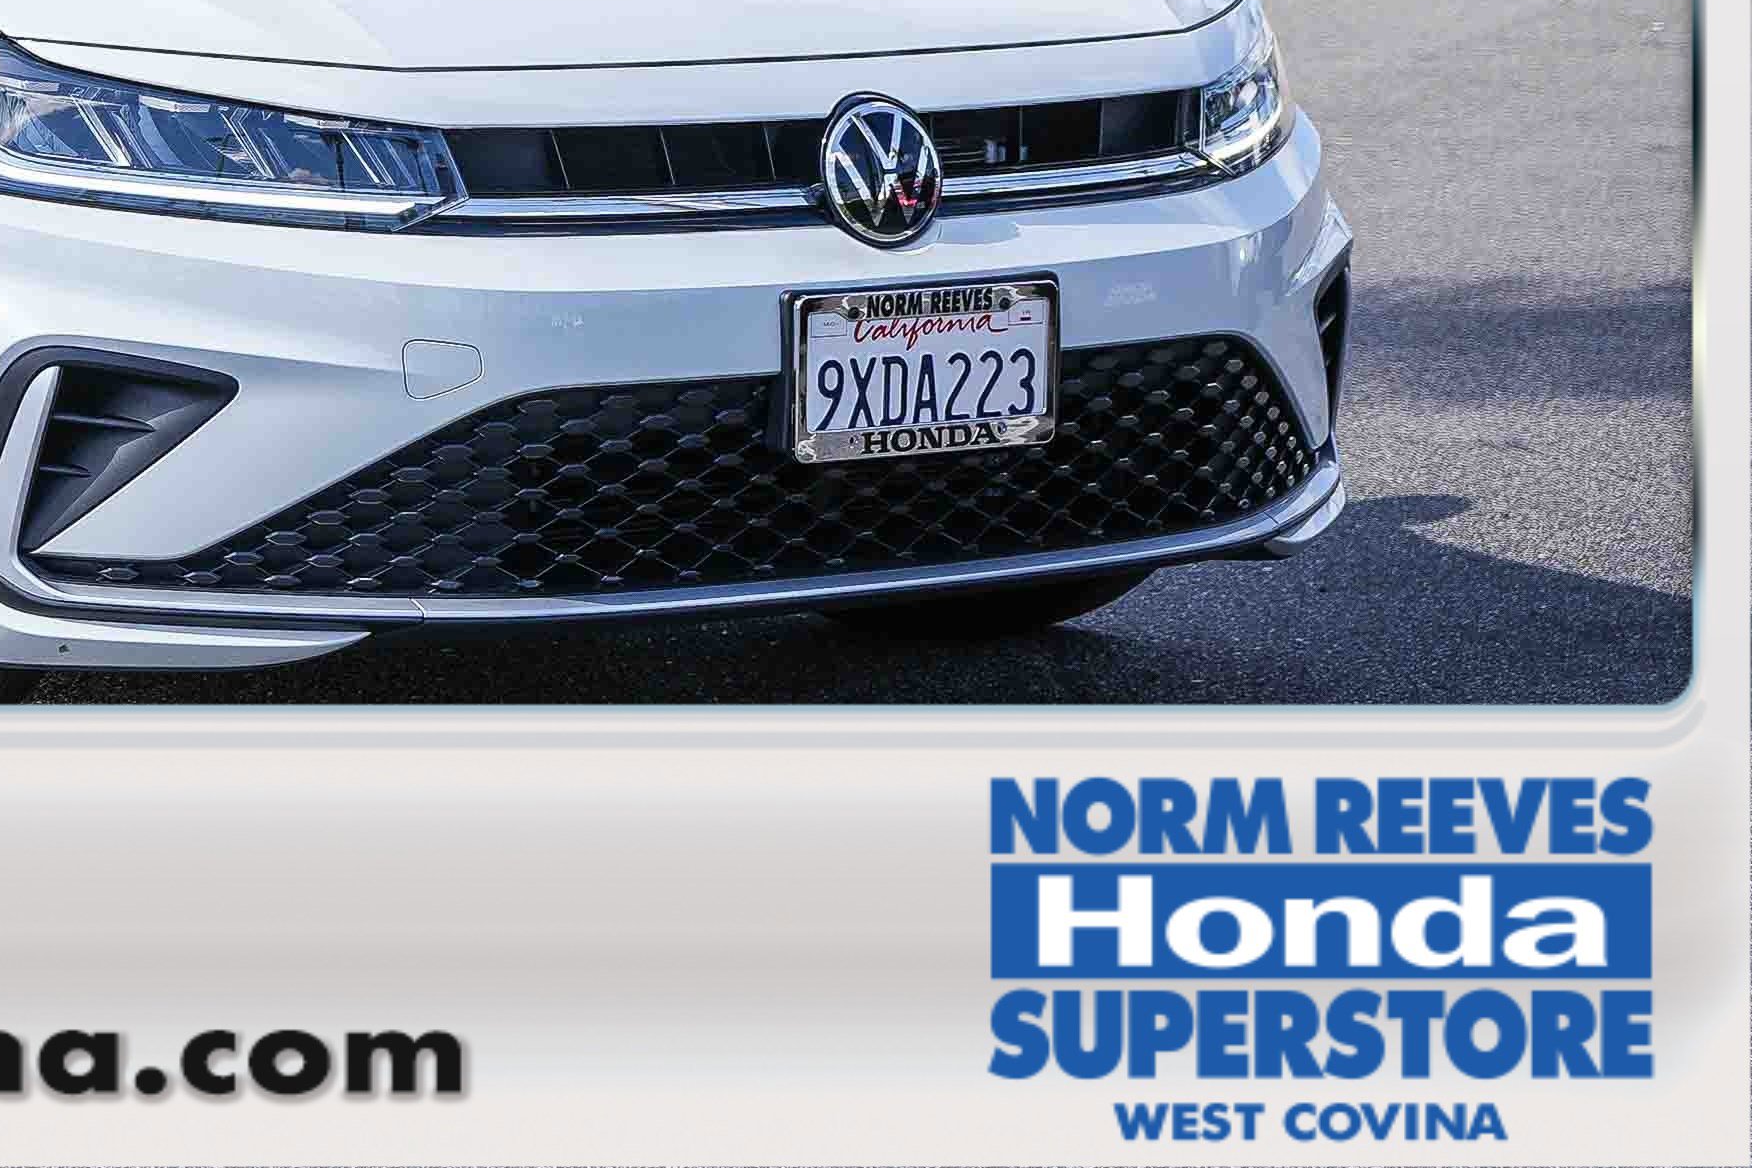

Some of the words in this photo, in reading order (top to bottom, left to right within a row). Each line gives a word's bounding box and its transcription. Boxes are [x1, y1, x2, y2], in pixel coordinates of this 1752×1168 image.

[866, 292, 923, 319] NORM
[931, 288, 993, 314] REEVES
[854, 314, 1008, 351] California
[815, 348, 1037, 432] 9XDA223
[860, 422, 1000, 455] HONDA
